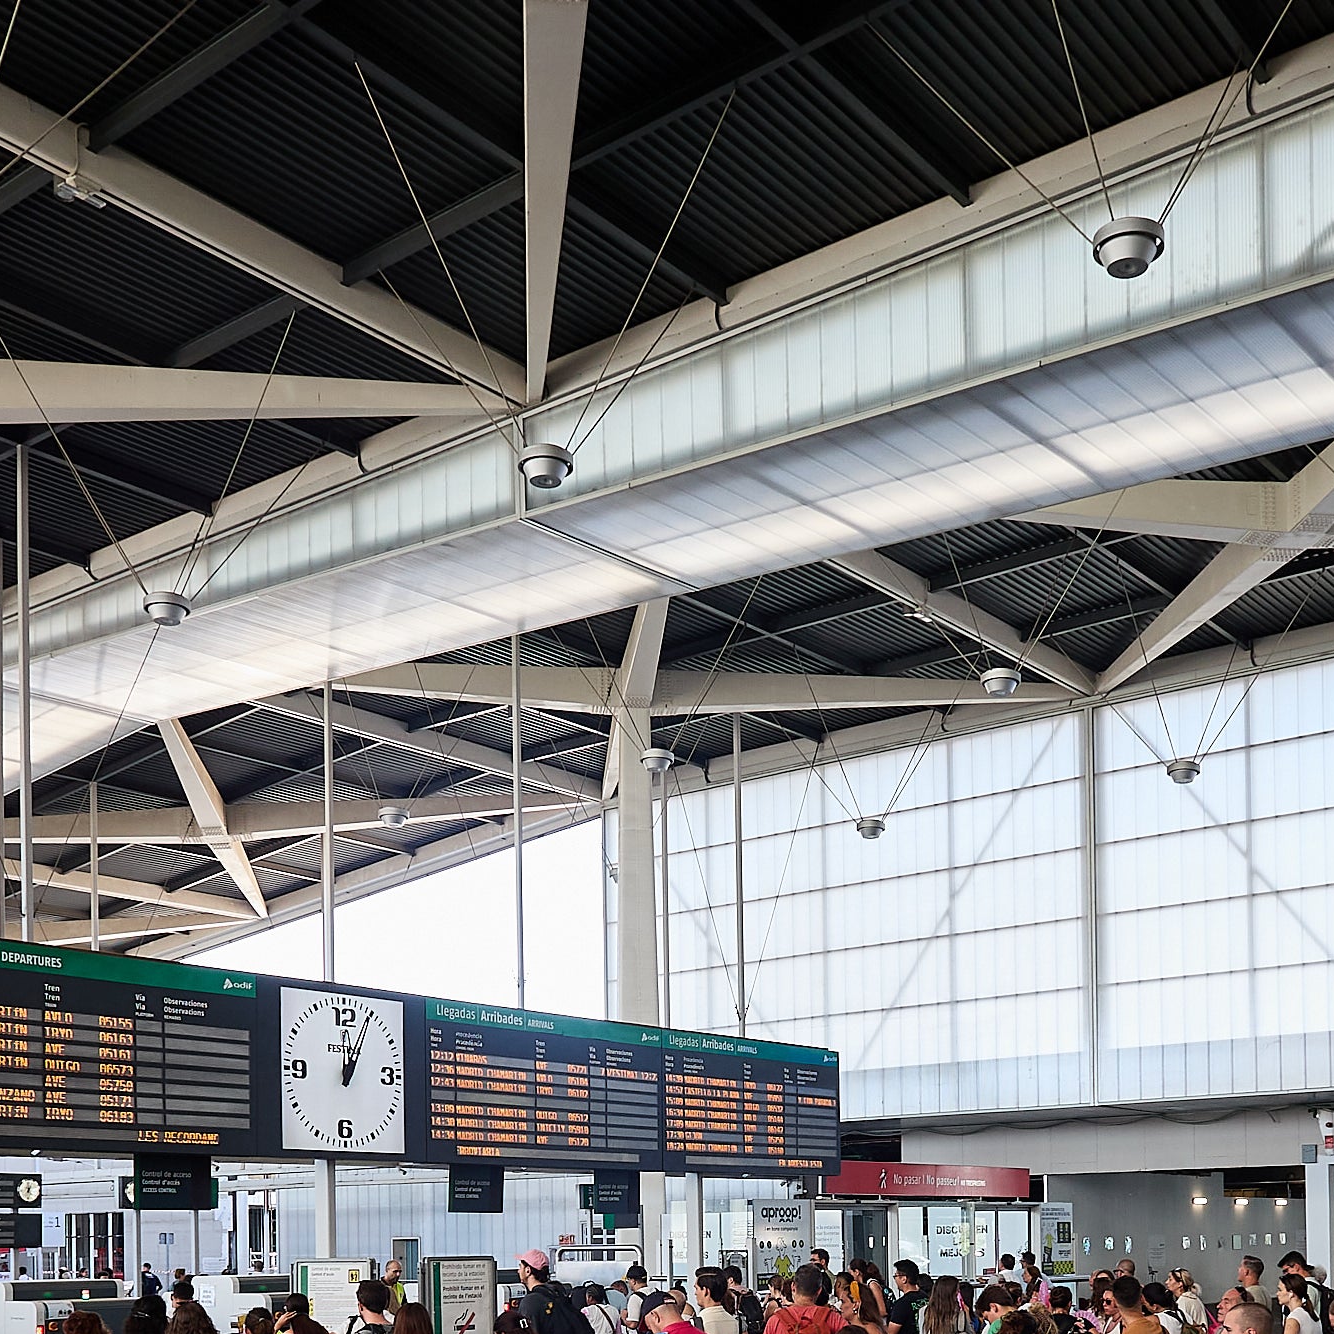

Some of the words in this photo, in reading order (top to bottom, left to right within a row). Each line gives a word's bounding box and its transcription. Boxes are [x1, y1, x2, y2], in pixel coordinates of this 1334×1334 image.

[1, 951, 63, 968] DEPARTURES
[233, 982, 253, 991] adif
[331, 1006, 357, 1028] 12
[436, 1004, 476, 1020] Llegadas
[480, 1009, 523, 1026] Arribades
[527, 1019, 555, 1030] ARRIVALS
[669, 1034, 699, 1048] Llegadas
[702, 1038, 735, 1052] Arribades
[291, 1059, 308, 1079] 9
[380, 1066, 395, 1086] 3
[337, 1119, 353, 1139] 6
[893, 1174, 903, 1185] No
[903, 1175, 922, 1187] pasar
[926, 1174, 935, 1185] No
[761, 1205, 802, 1222] aproop!
[54, 1216, 61, 1228] 1
